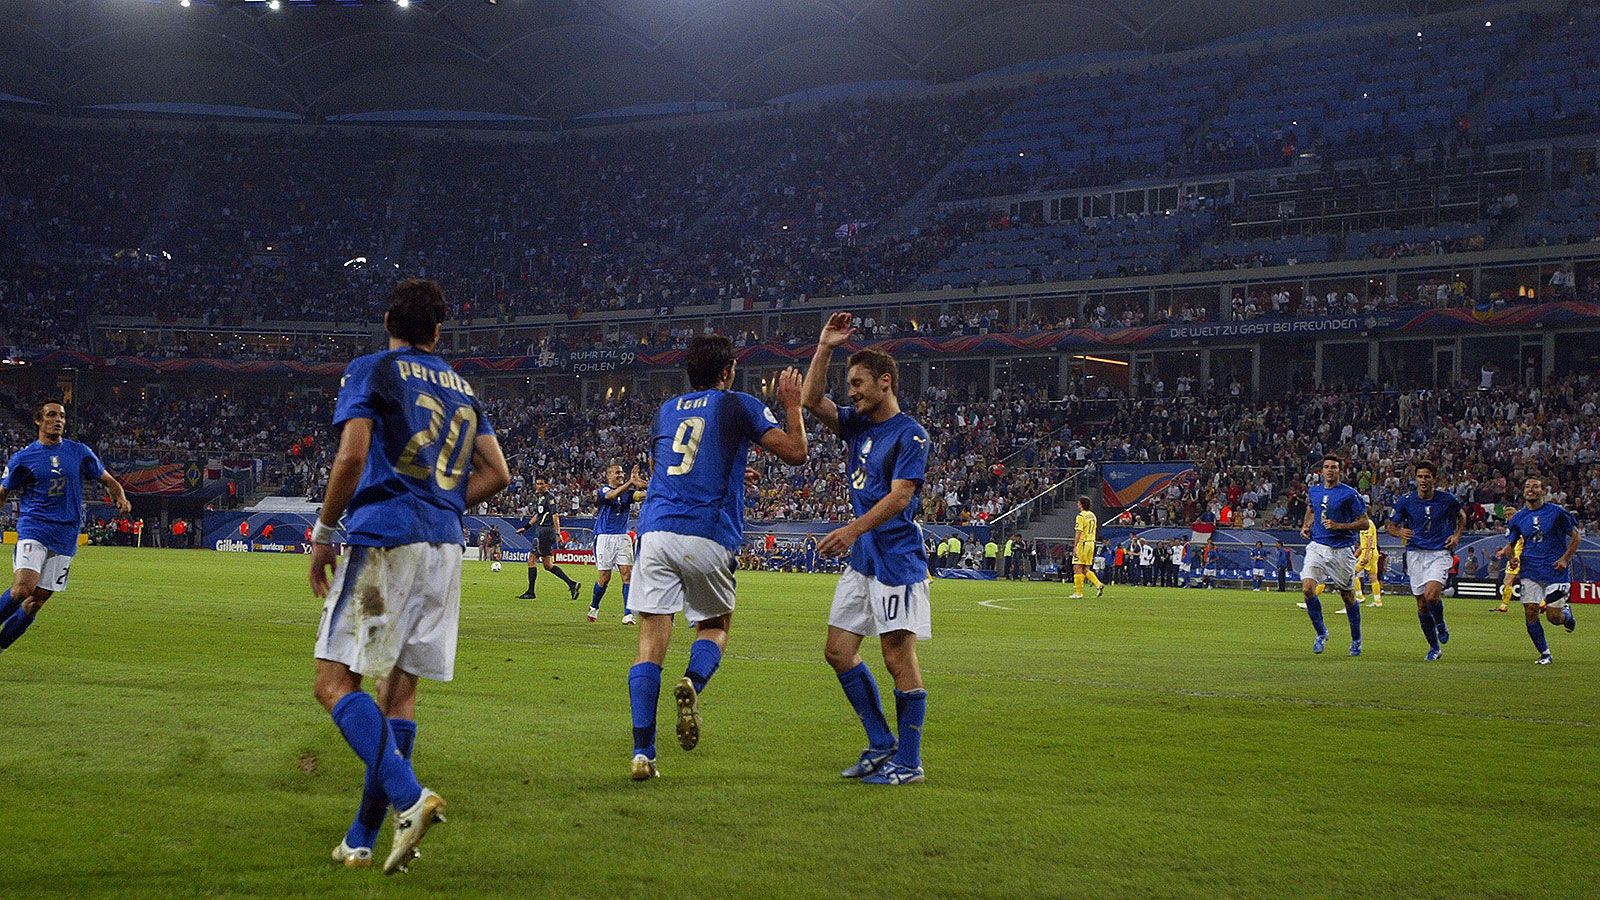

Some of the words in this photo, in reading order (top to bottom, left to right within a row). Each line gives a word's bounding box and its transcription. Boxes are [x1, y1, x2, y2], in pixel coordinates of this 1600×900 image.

[1170, 327, 1188, 338] DIE
[1189, 326, 1220, 337] WELT
[1222, 325, 1238, 336] ZU
[1239, 323, 1272, 334] GAST
[1273, 321, 1291, 333] BEI
[1293, 319, 1358, 332] FREUNDEN
[570, 350, 619, 361] RUHRTAL
[620, 351, 635, 365] 99
[573, 362, 616, 373] FOHLEN
[394, 393, 478, 491] 20
[666, 416, 706, 476] 9
[47, 478, 67, 496] 22
[215, 540, 248, 553] Gillette
[882, 594, 900, 622] 10
